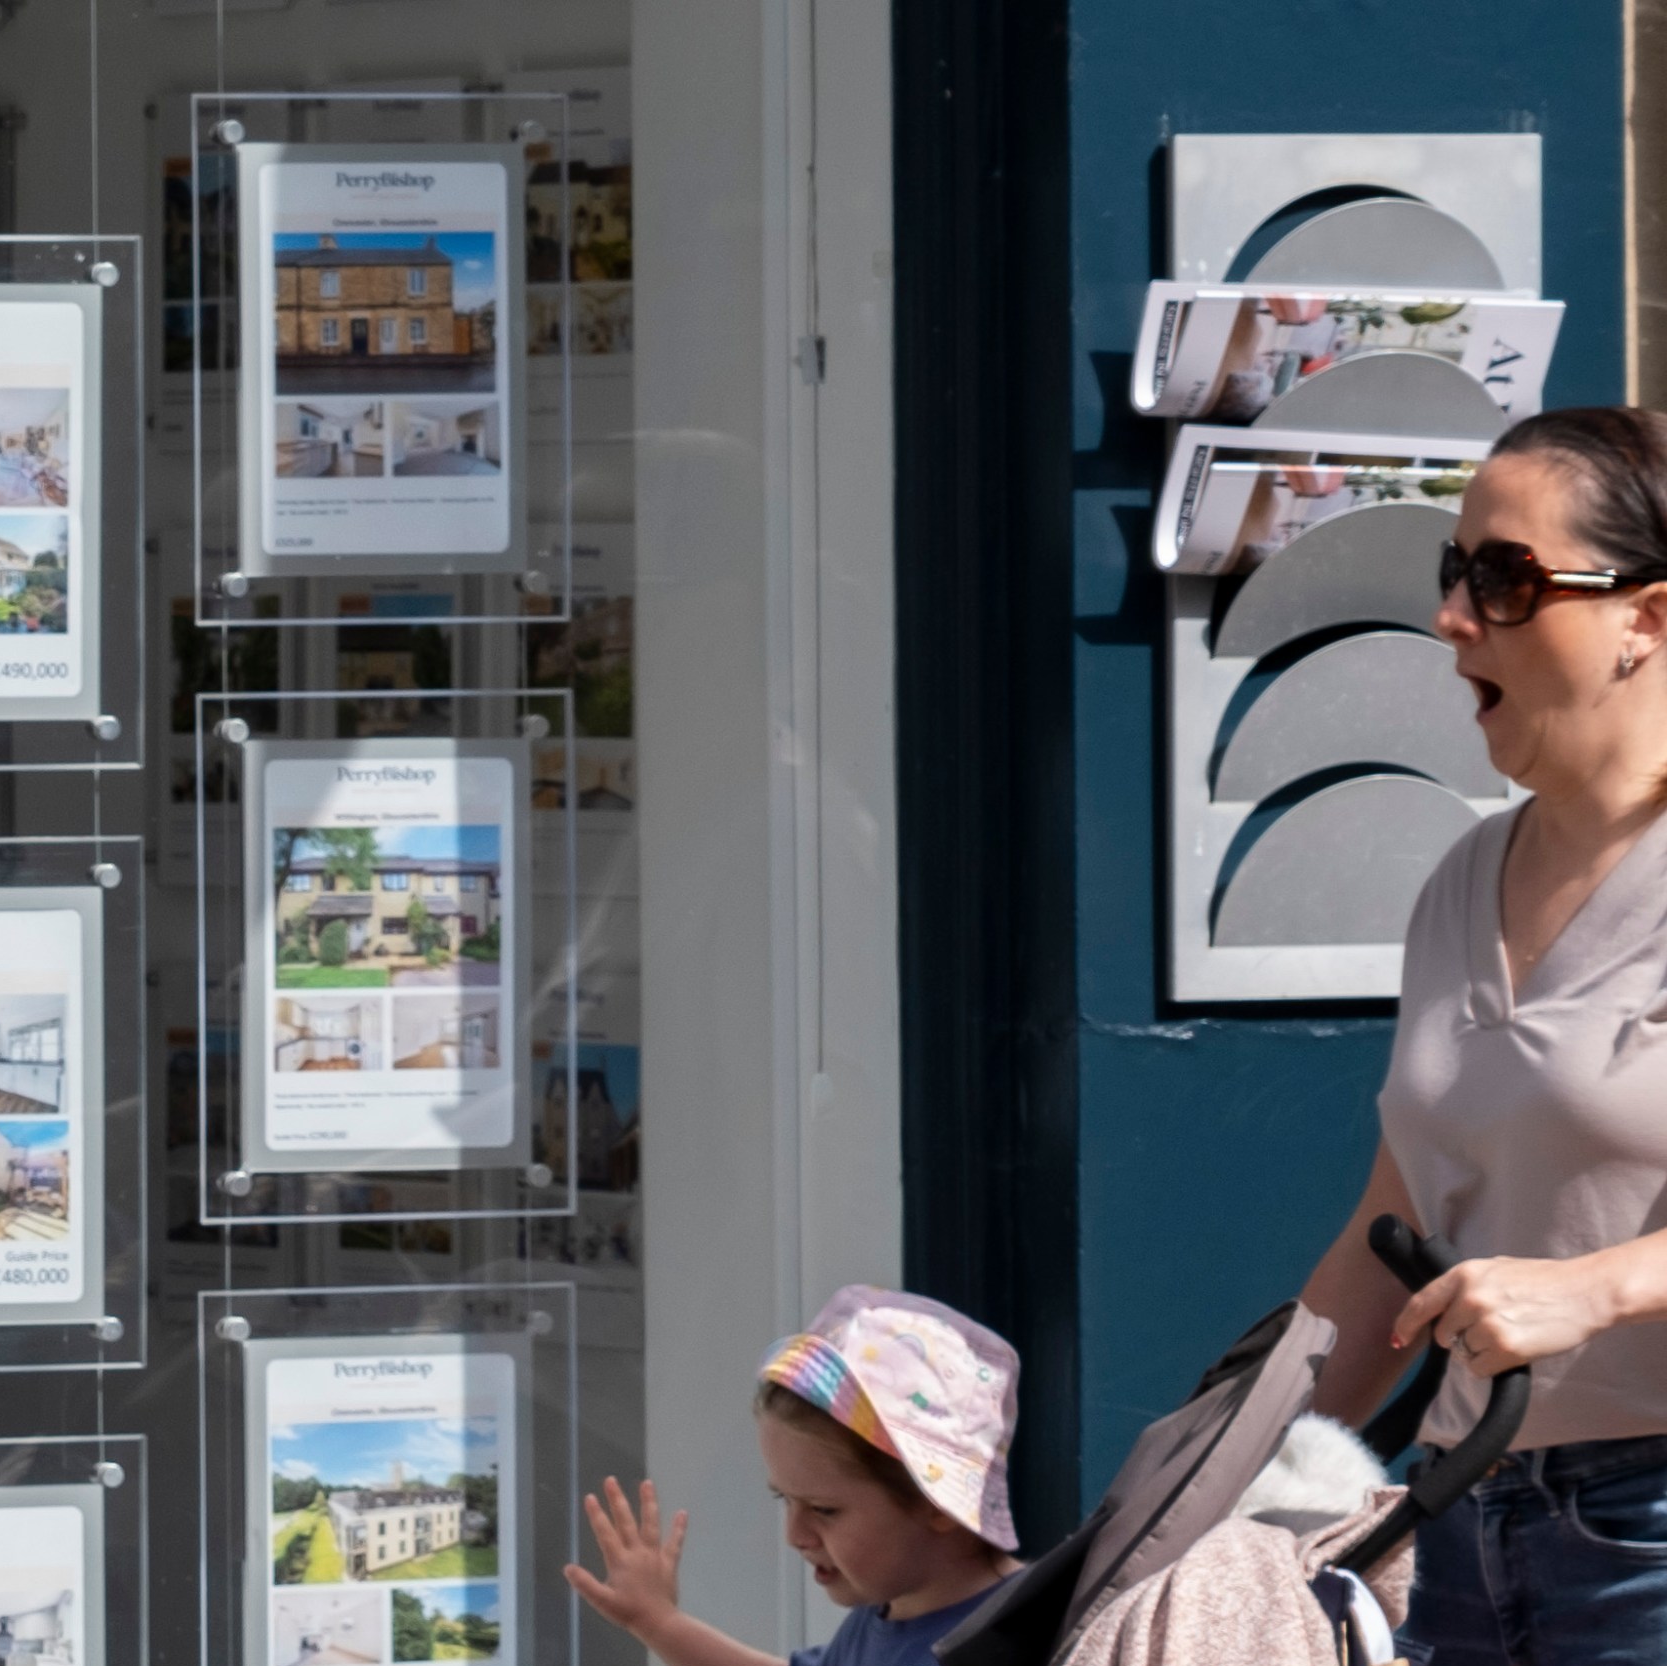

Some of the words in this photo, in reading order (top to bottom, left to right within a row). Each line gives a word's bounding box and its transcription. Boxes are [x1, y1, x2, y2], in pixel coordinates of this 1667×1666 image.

[335, 171, 435, 192] PerryBishop
[5, 1250, 39, 1263] Guide
[41, 1250, 70, 1262] Price
